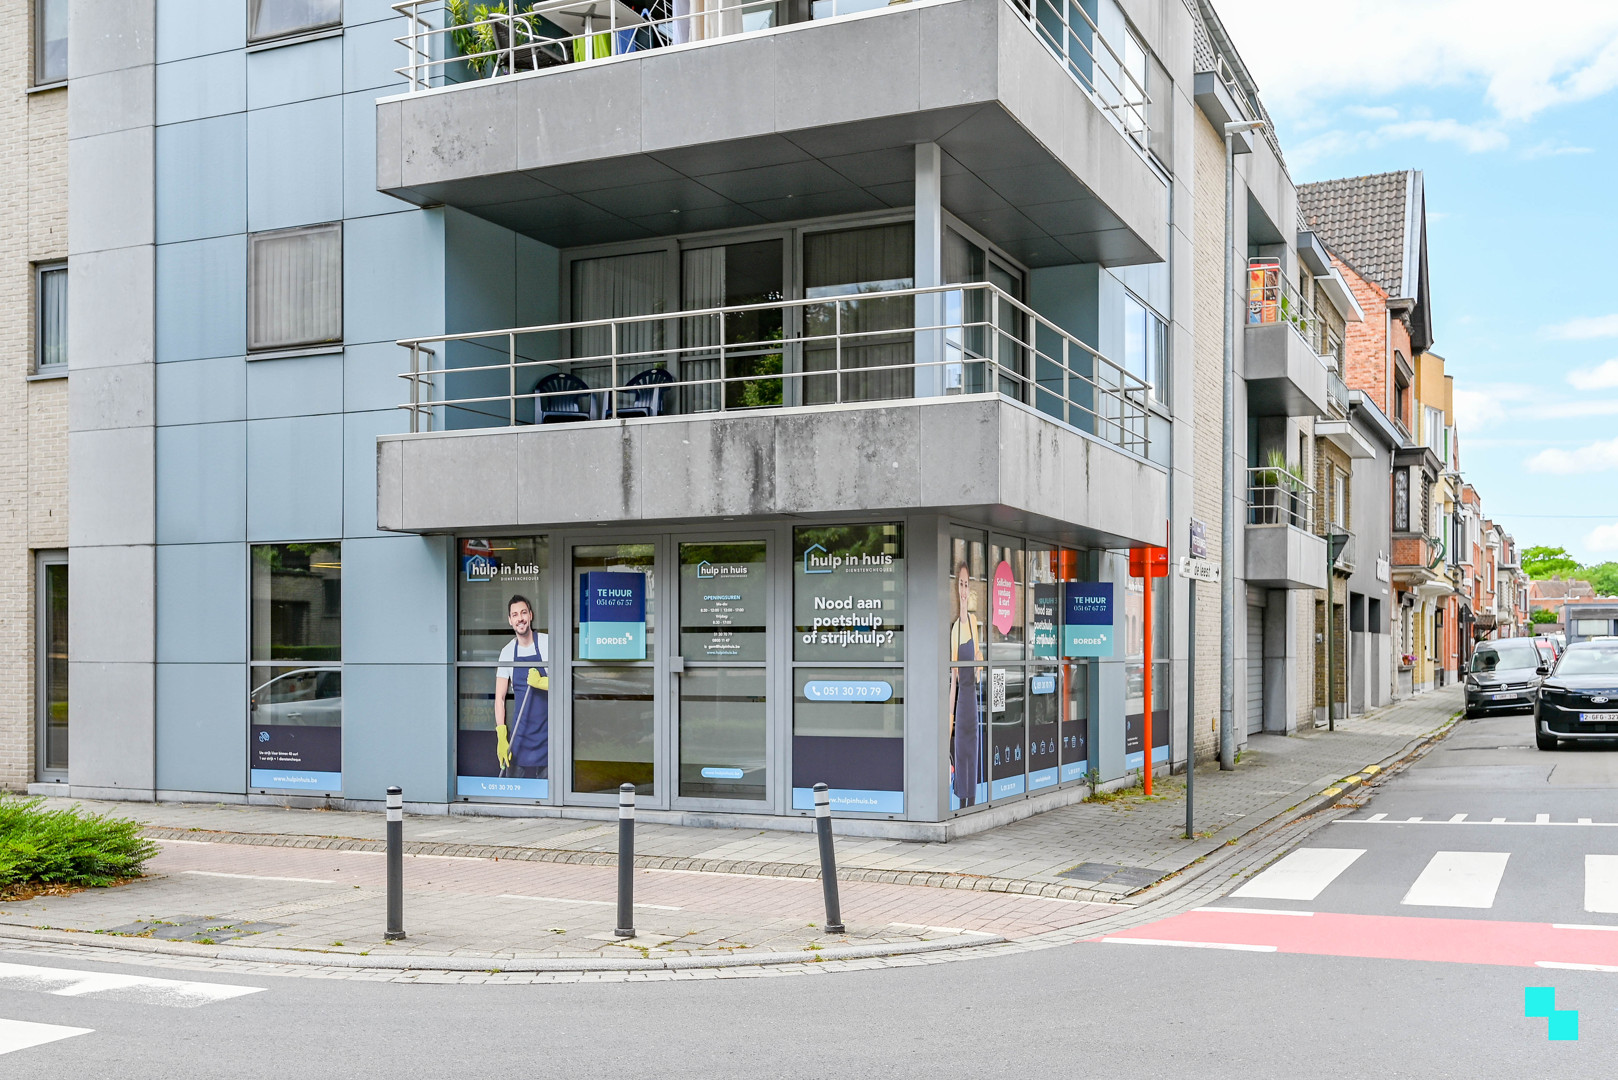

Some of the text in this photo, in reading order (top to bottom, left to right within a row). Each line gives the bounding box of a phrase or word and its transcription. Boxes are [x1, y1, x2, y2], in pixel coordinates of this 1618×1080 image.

[810, 552, 892, 569] hulp in huis
[472, 562, 539, 578] hulp in huis
[701, 565, 748, 575] hulp in huis
[597, 589, 632, 597] TE HUUR
[814, 596, 882, 610] Nood aan
[1034, 604, 1046, 615] Nood
[814, 613, 882, 630] poetshulp
[1034, 619, 1052, 633] poetshulp
[802, 630, 894, 647] of strijkhulp?
[823, 687, 881, 696] 051 30 70 79
